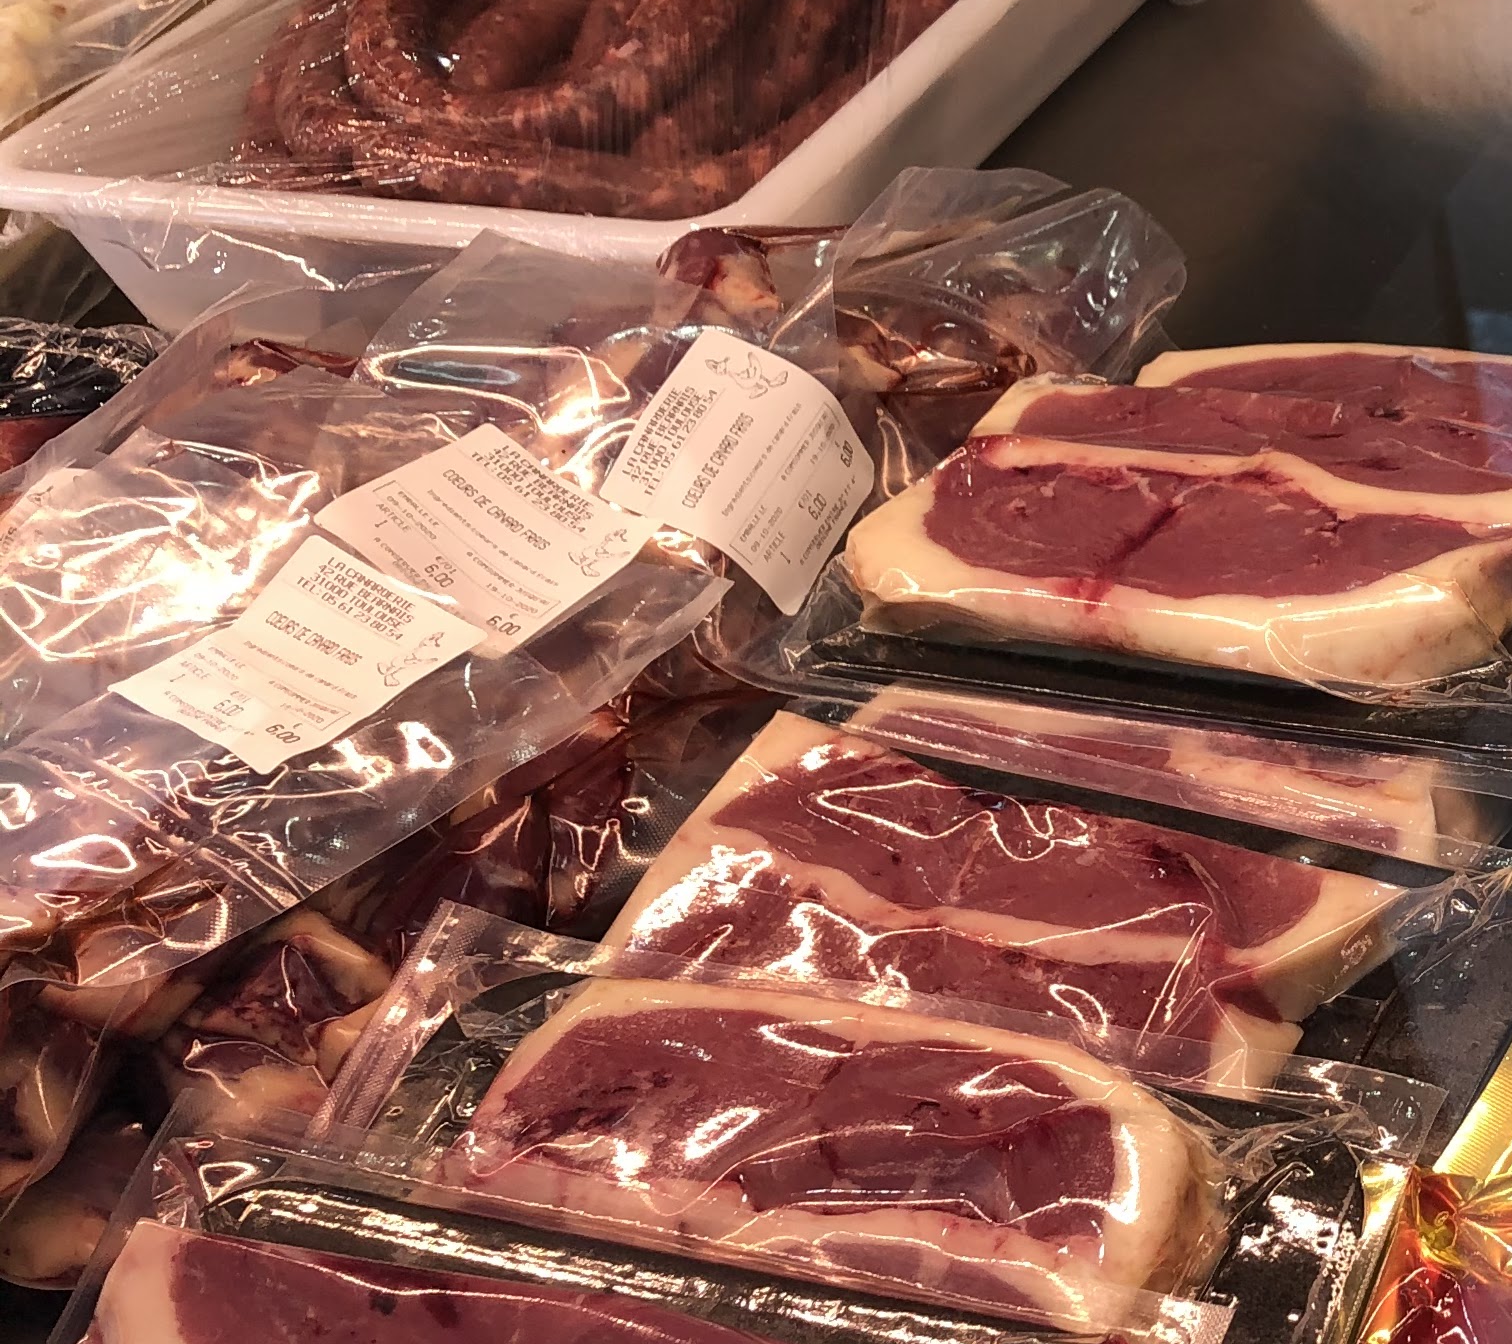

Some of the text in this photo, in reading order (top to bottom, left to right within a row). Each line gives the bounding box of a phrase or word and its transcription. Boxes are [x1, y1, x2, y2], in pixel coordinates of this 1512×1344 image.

[621, 456, 638, 476] LA
[681, 475, 712, 509] COEURS
[701, 462, 720, 479] DE
[375, 503, 412, 531] ARTICLE
[442, 469, 551, 551] COEURS DE CANARD FRAIS
[327, 556, 347, 572] LA
[310, 573, 349, 599] 31000
[333, 573, 357, 592] RUE
[321, 591, 337, 606] 05
[265, 610, 300, 635] COEURS
[292, 626, 312, 642] DE
